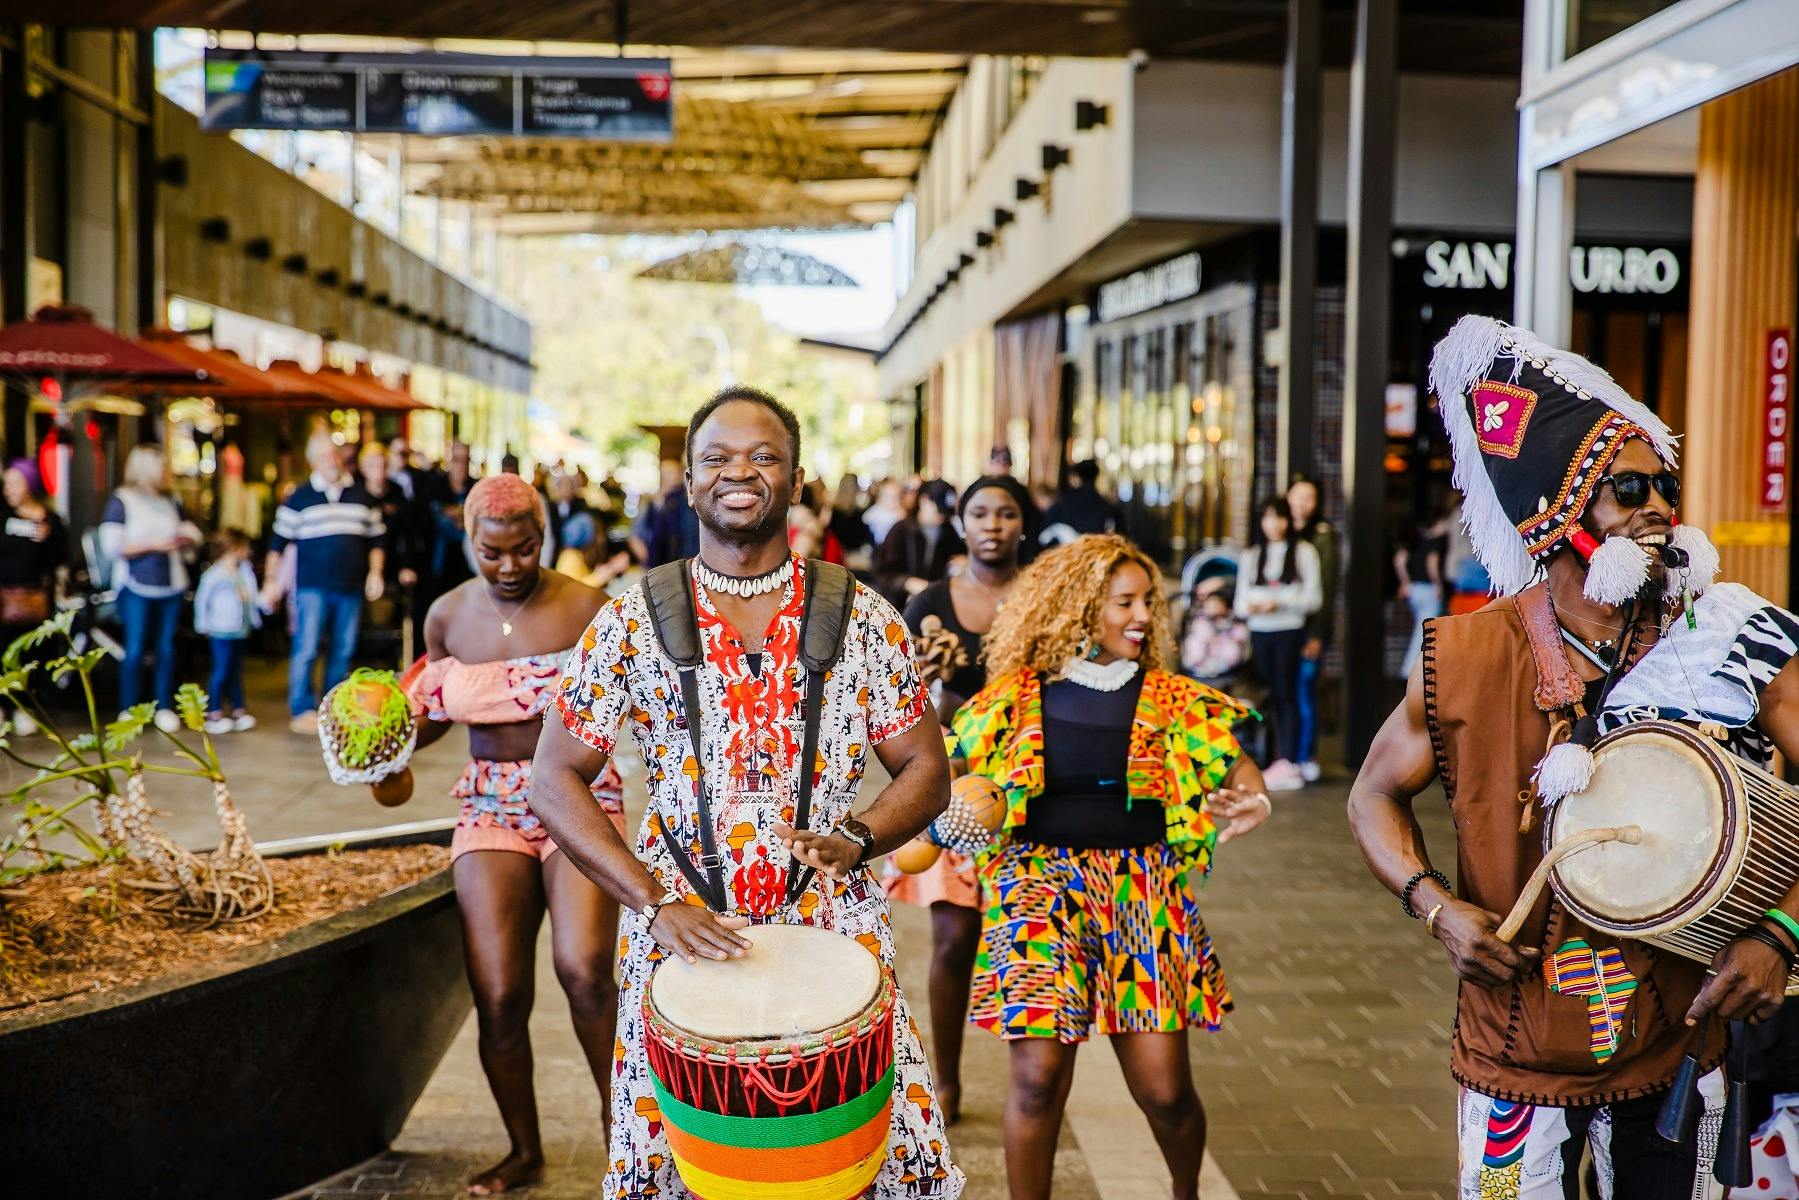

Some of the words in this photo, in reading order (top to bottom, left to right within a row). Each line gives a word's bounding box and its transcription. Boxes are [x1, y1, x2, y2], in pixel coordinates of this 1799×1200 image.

[1424, 240, 1511, 290] SAN
[1571, 246, 1680, 294] URRO
[1766, 337, 1788, 503] ORDER
